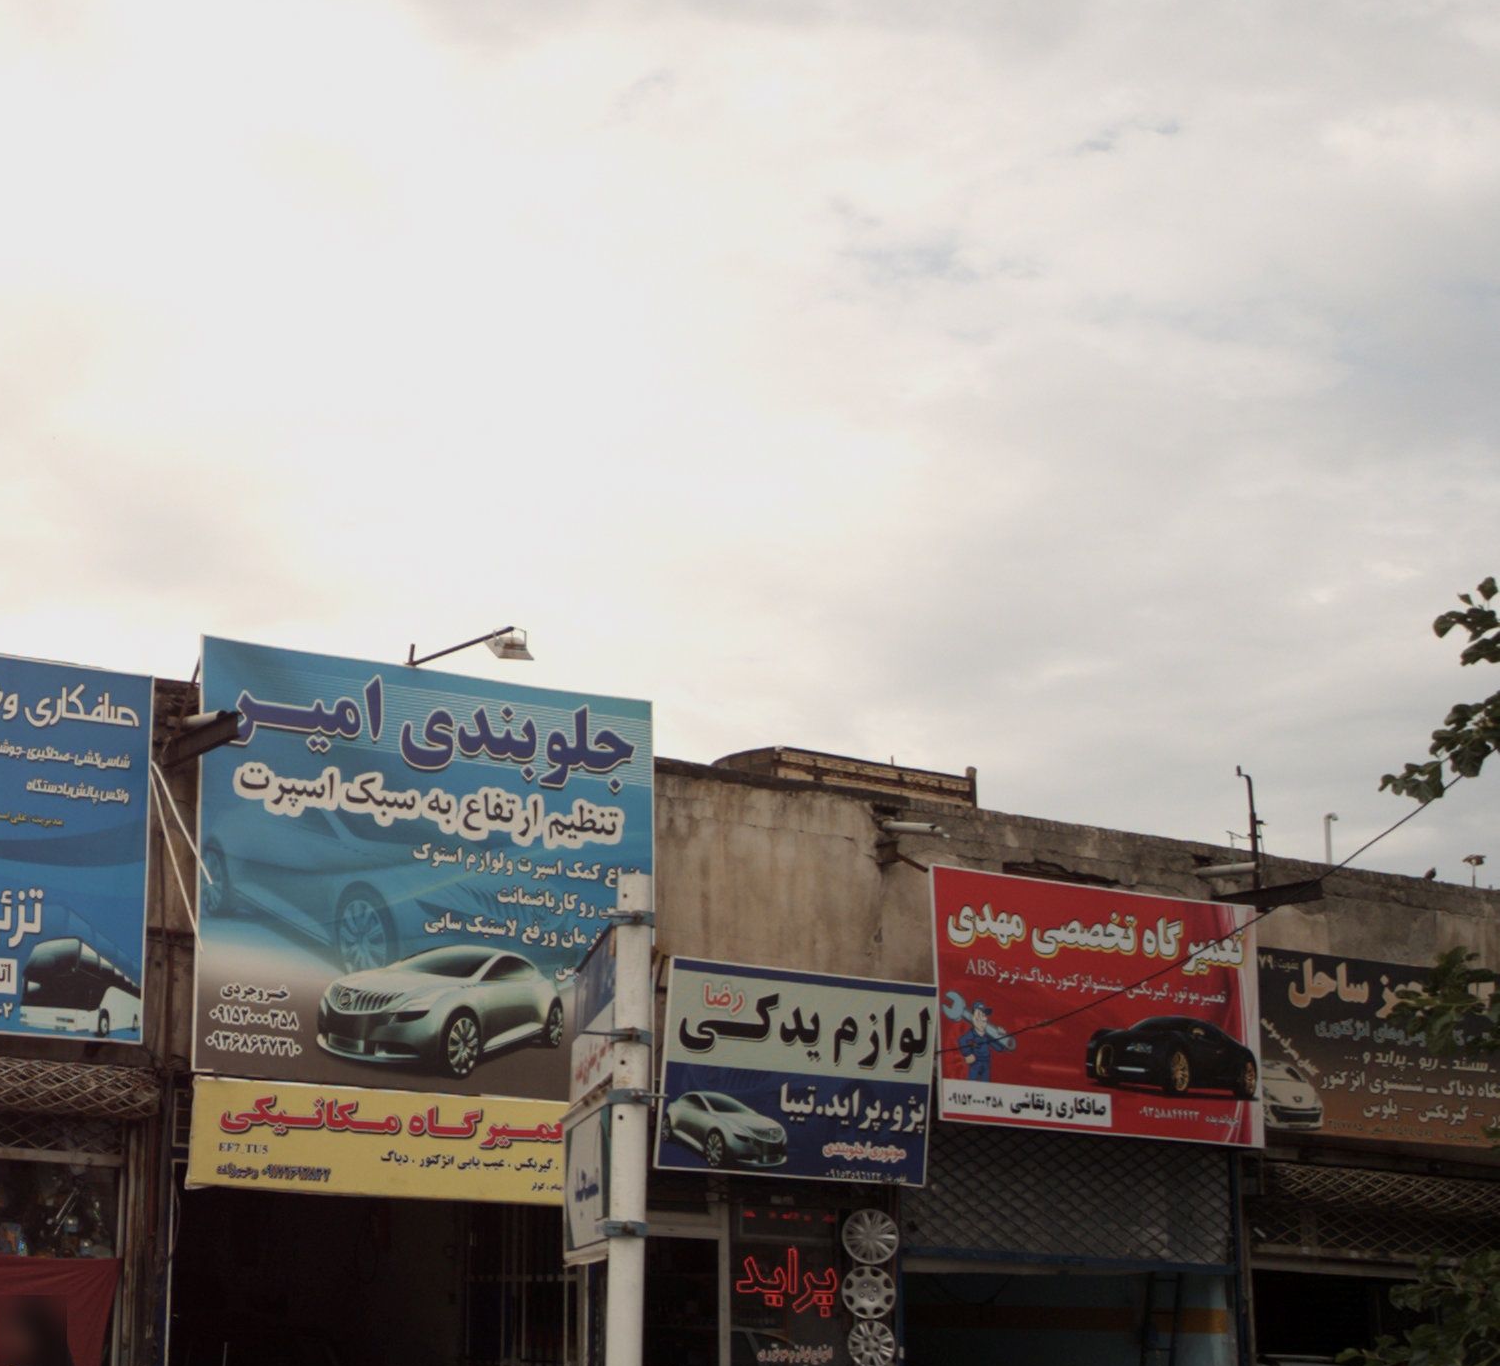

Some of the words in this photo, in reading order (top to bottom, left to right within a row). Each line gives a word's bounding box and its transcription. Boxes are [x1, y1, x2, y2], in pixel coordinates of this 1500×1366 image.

[24, 684, 140, 727] صافکاری
[228, 674, 384, 754] امیر
[399, 703, 635, 793] جلوبندی
[240, 767, 335, 808] اسپرت
[345, 777, 417, 817] سبک
[427, 793, 453, 825] به
[462, 792, 539, 838] ارتفاع
[548, 803, 619, 840] تنظیم
[412, 842, 463, 868] استوک
[517, 858, 564, 881] اسپرت
[565, 861, 601, 881] کمک
[465, 914, 519, 939] لاستیک
[947, 902, 1025, 947] مهدی
[1032, 912, 1138, 958] تخصصی
[965, 958, 996, 977] ABS
[1288, 957, 1369, 1009] ساحل
[701, 982, 747, 1015] رضا
[679, 993, 820, 1063] یدکی
[834, 1004, 933, 1072] لوازم
[1374, 1050, 1408, 1072] پراید
[219, 1095, 401, 1137] مکانیکی
[1056, 1097, 1107, 1120] صافکاری
[1362, 1098, 1399, 1121] پلوس
[380, 1150, 410, 1167] دیاگ
[419, 1153, 456, 1170] انژکتور
[514, 1157, 554, 1173] گیربکس
[736, 1245, 839, 1319] پراید
